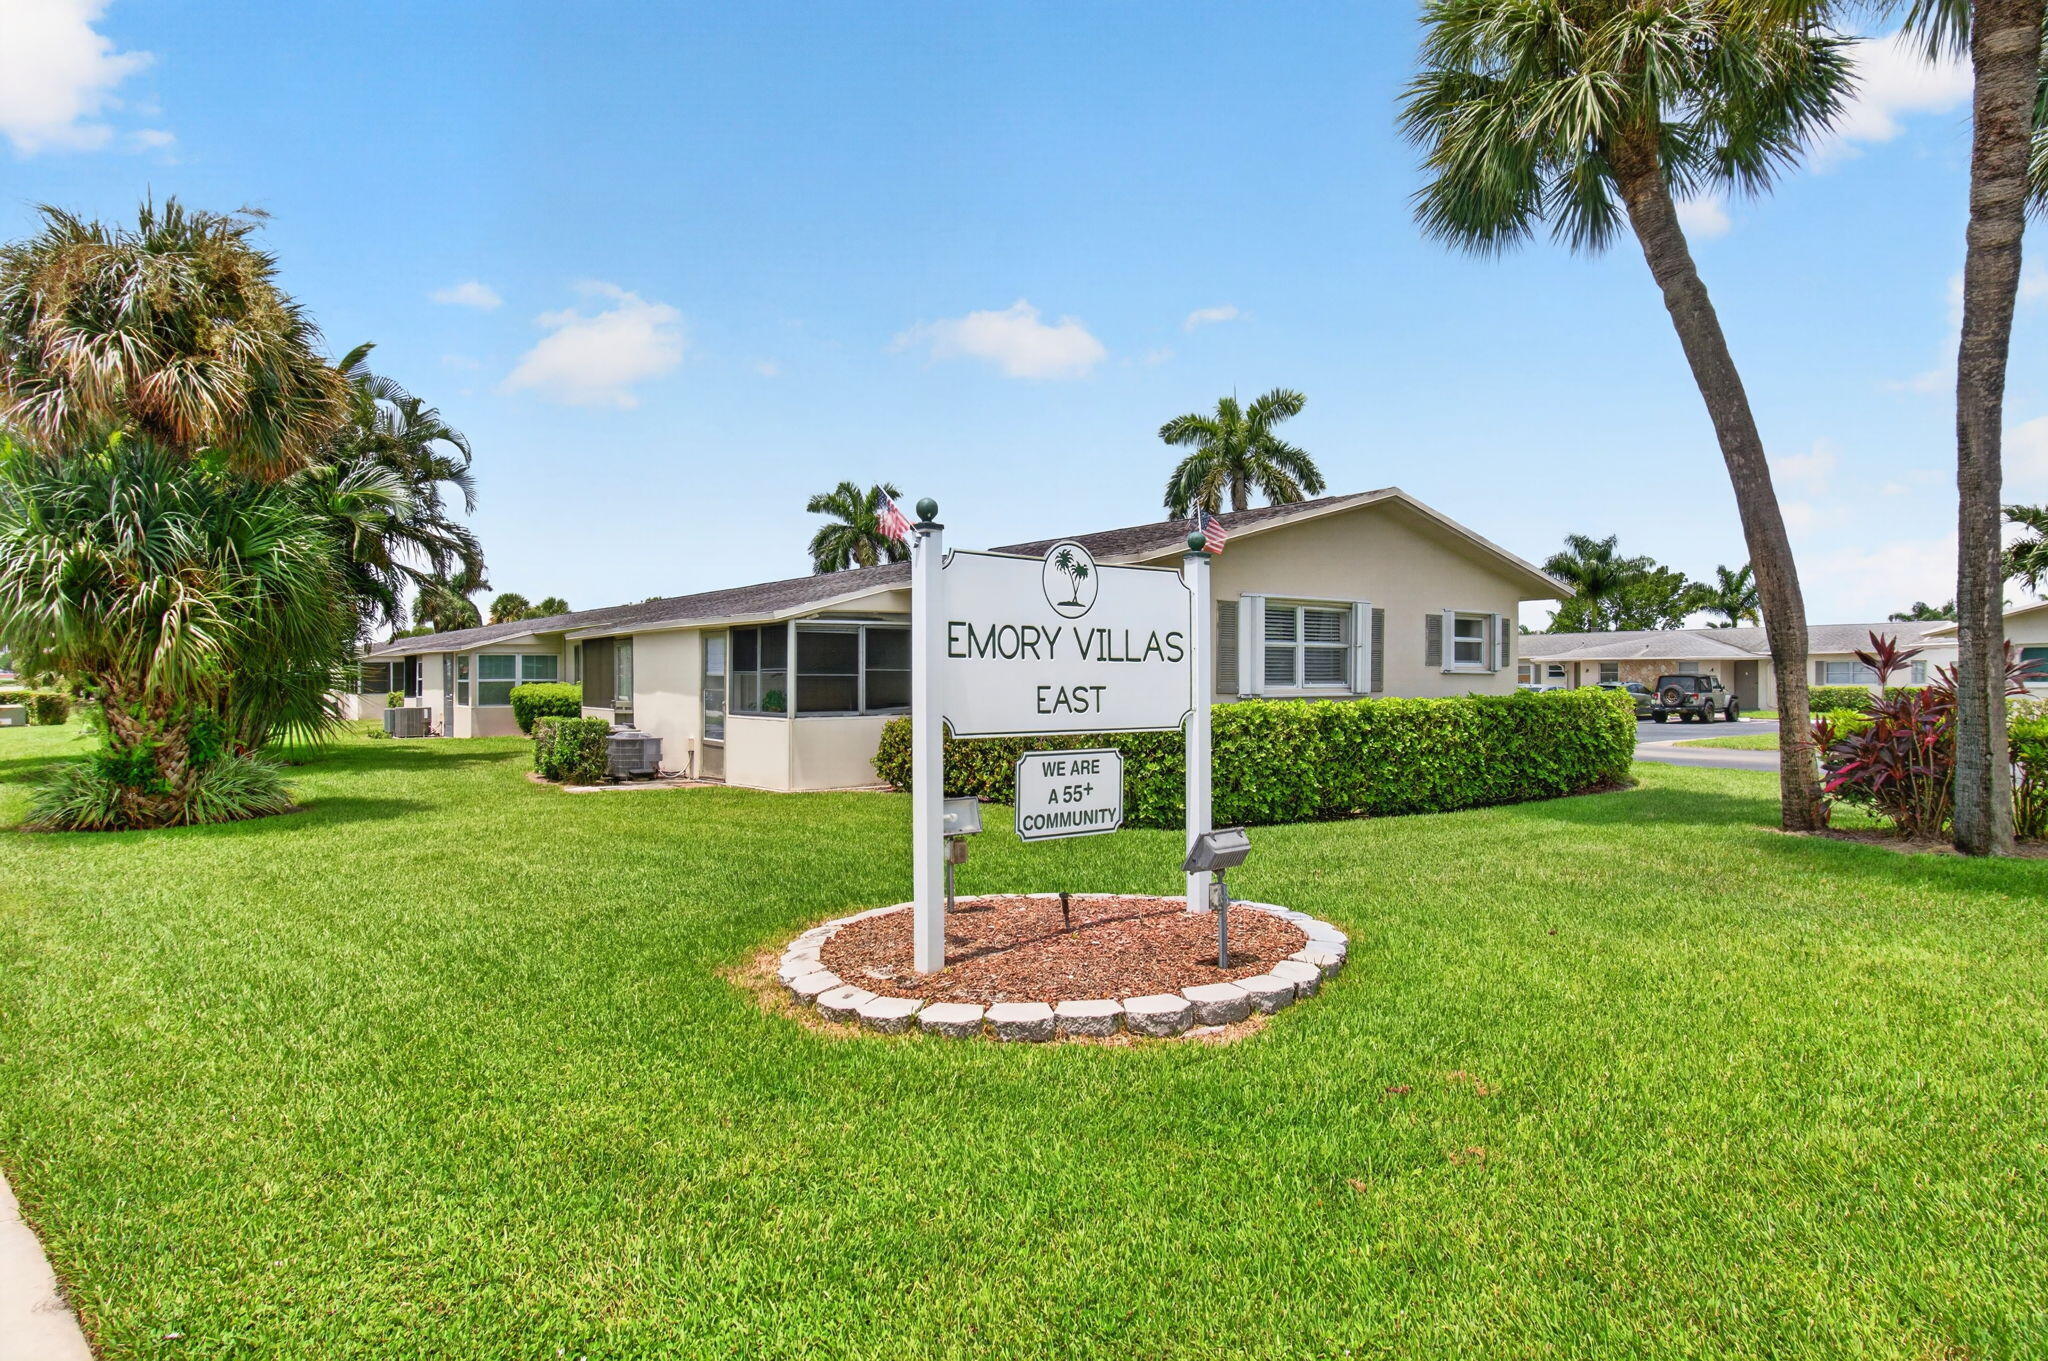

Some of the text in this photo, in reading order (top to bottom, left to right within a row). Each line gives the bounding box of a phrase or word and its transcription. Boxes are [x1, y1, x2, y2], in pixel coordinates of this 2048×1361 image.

[947, 621, 1184, 663] EMORY VILLAS
[1036, 685, 1107, 714] EAST
[1042, 759, 1100, 777] WE ARE
[1048, 781, 1094, 805] A 55+
[1022, 807, 1117, 831] COMMUNITY
